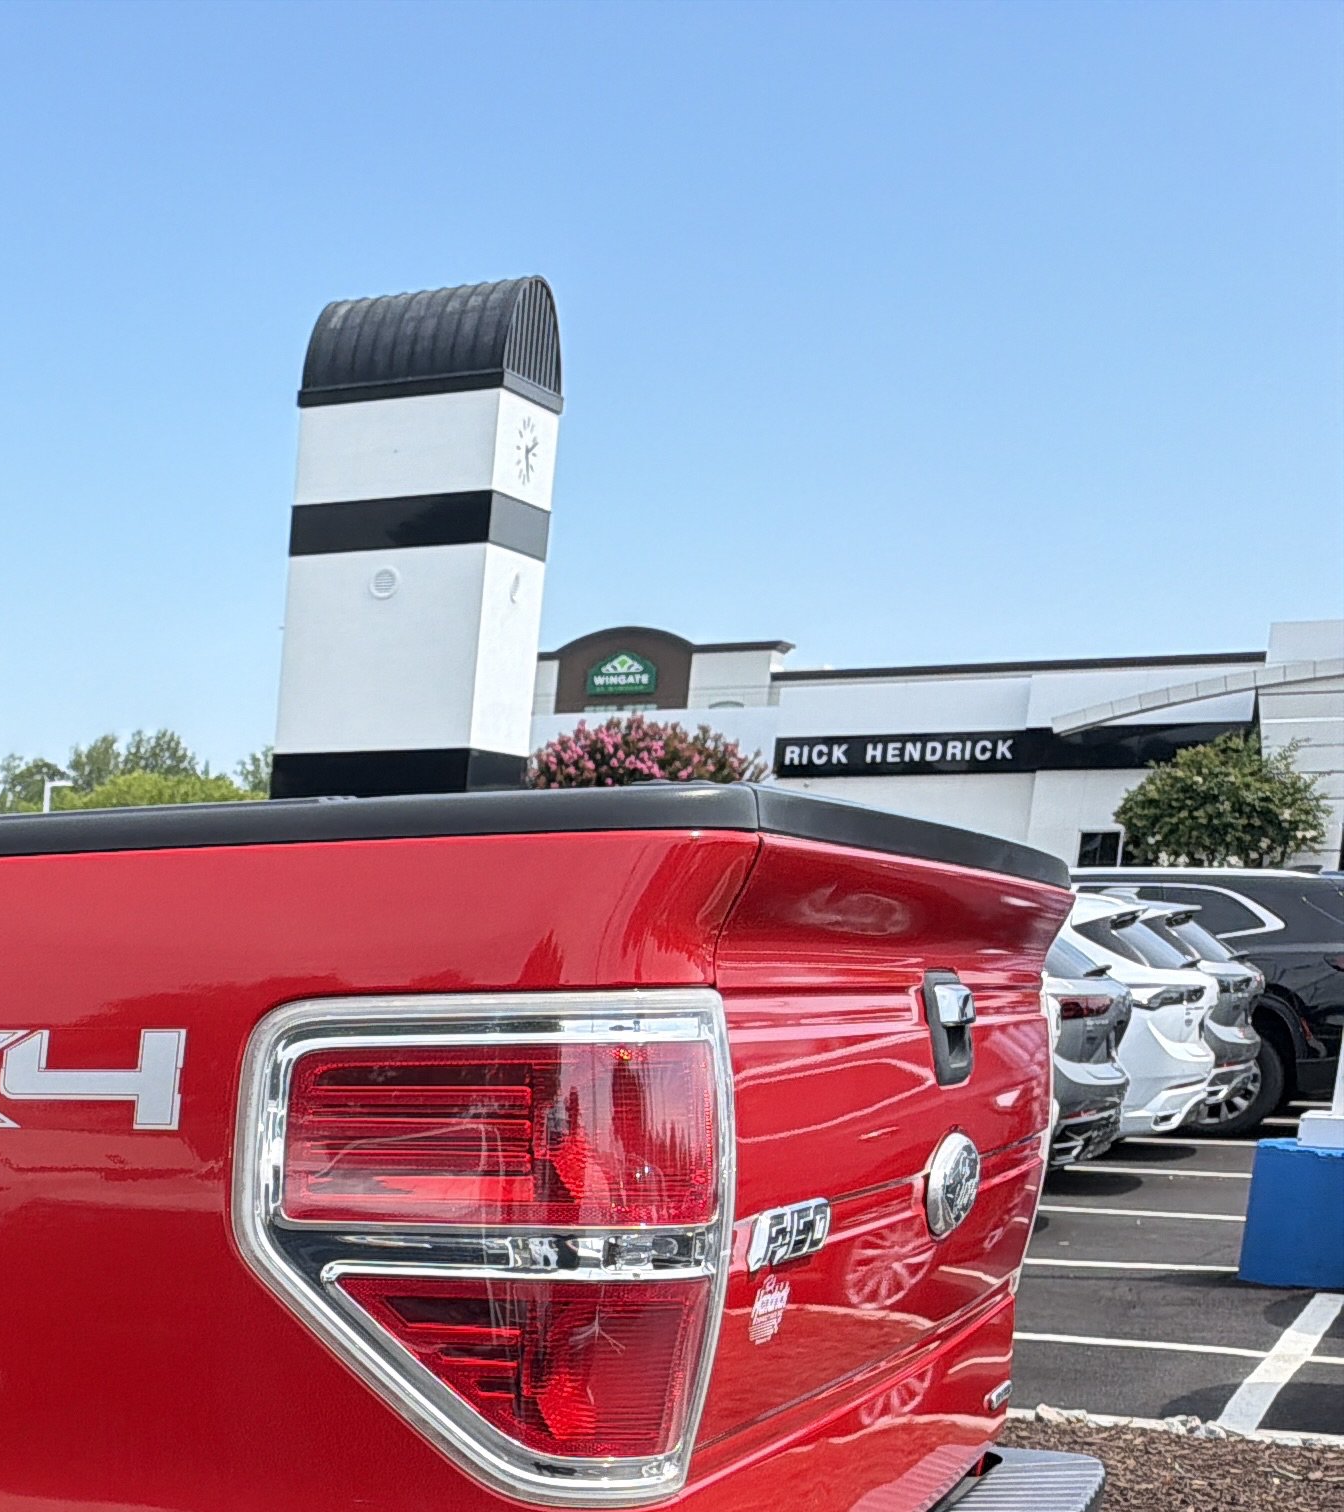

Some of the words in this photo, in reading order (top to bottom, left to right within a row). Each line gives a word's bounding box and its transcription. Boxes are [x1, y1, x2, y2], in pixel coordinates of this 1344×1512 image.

[593, 673, 650, 686] WINGATE
[783, 743, 849, 766] RICK
[865, 739, 1014, 764] HENDRICK
